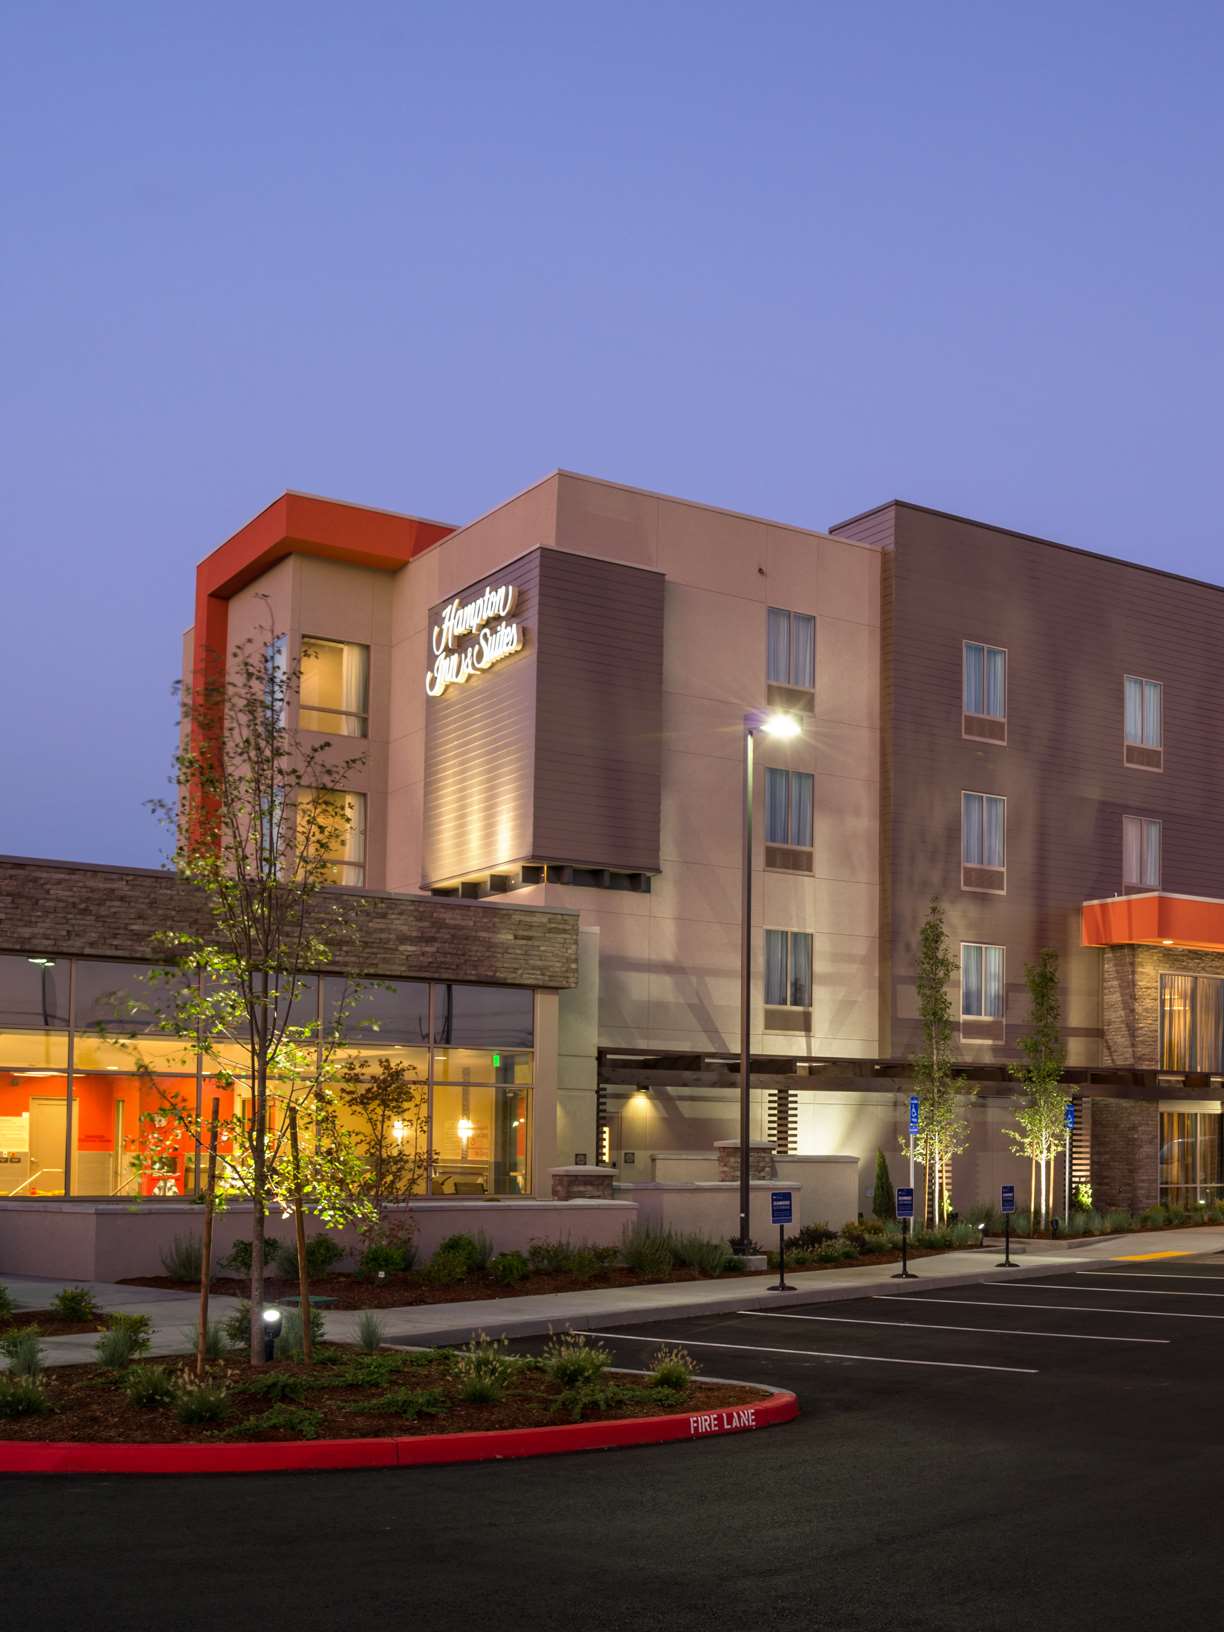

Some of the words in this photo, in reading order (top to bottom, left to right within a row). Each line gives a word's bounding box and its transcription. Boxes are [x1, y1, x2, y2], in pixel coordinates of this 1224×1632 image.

[432, 584, 514, 656] Hampton
[425, 651, 466, 697] Inn
[473, 620, 518, 669] Suites
[689, 1414, 719, 1434] FIRE
[722, 1409, 757, 1429] LANE
